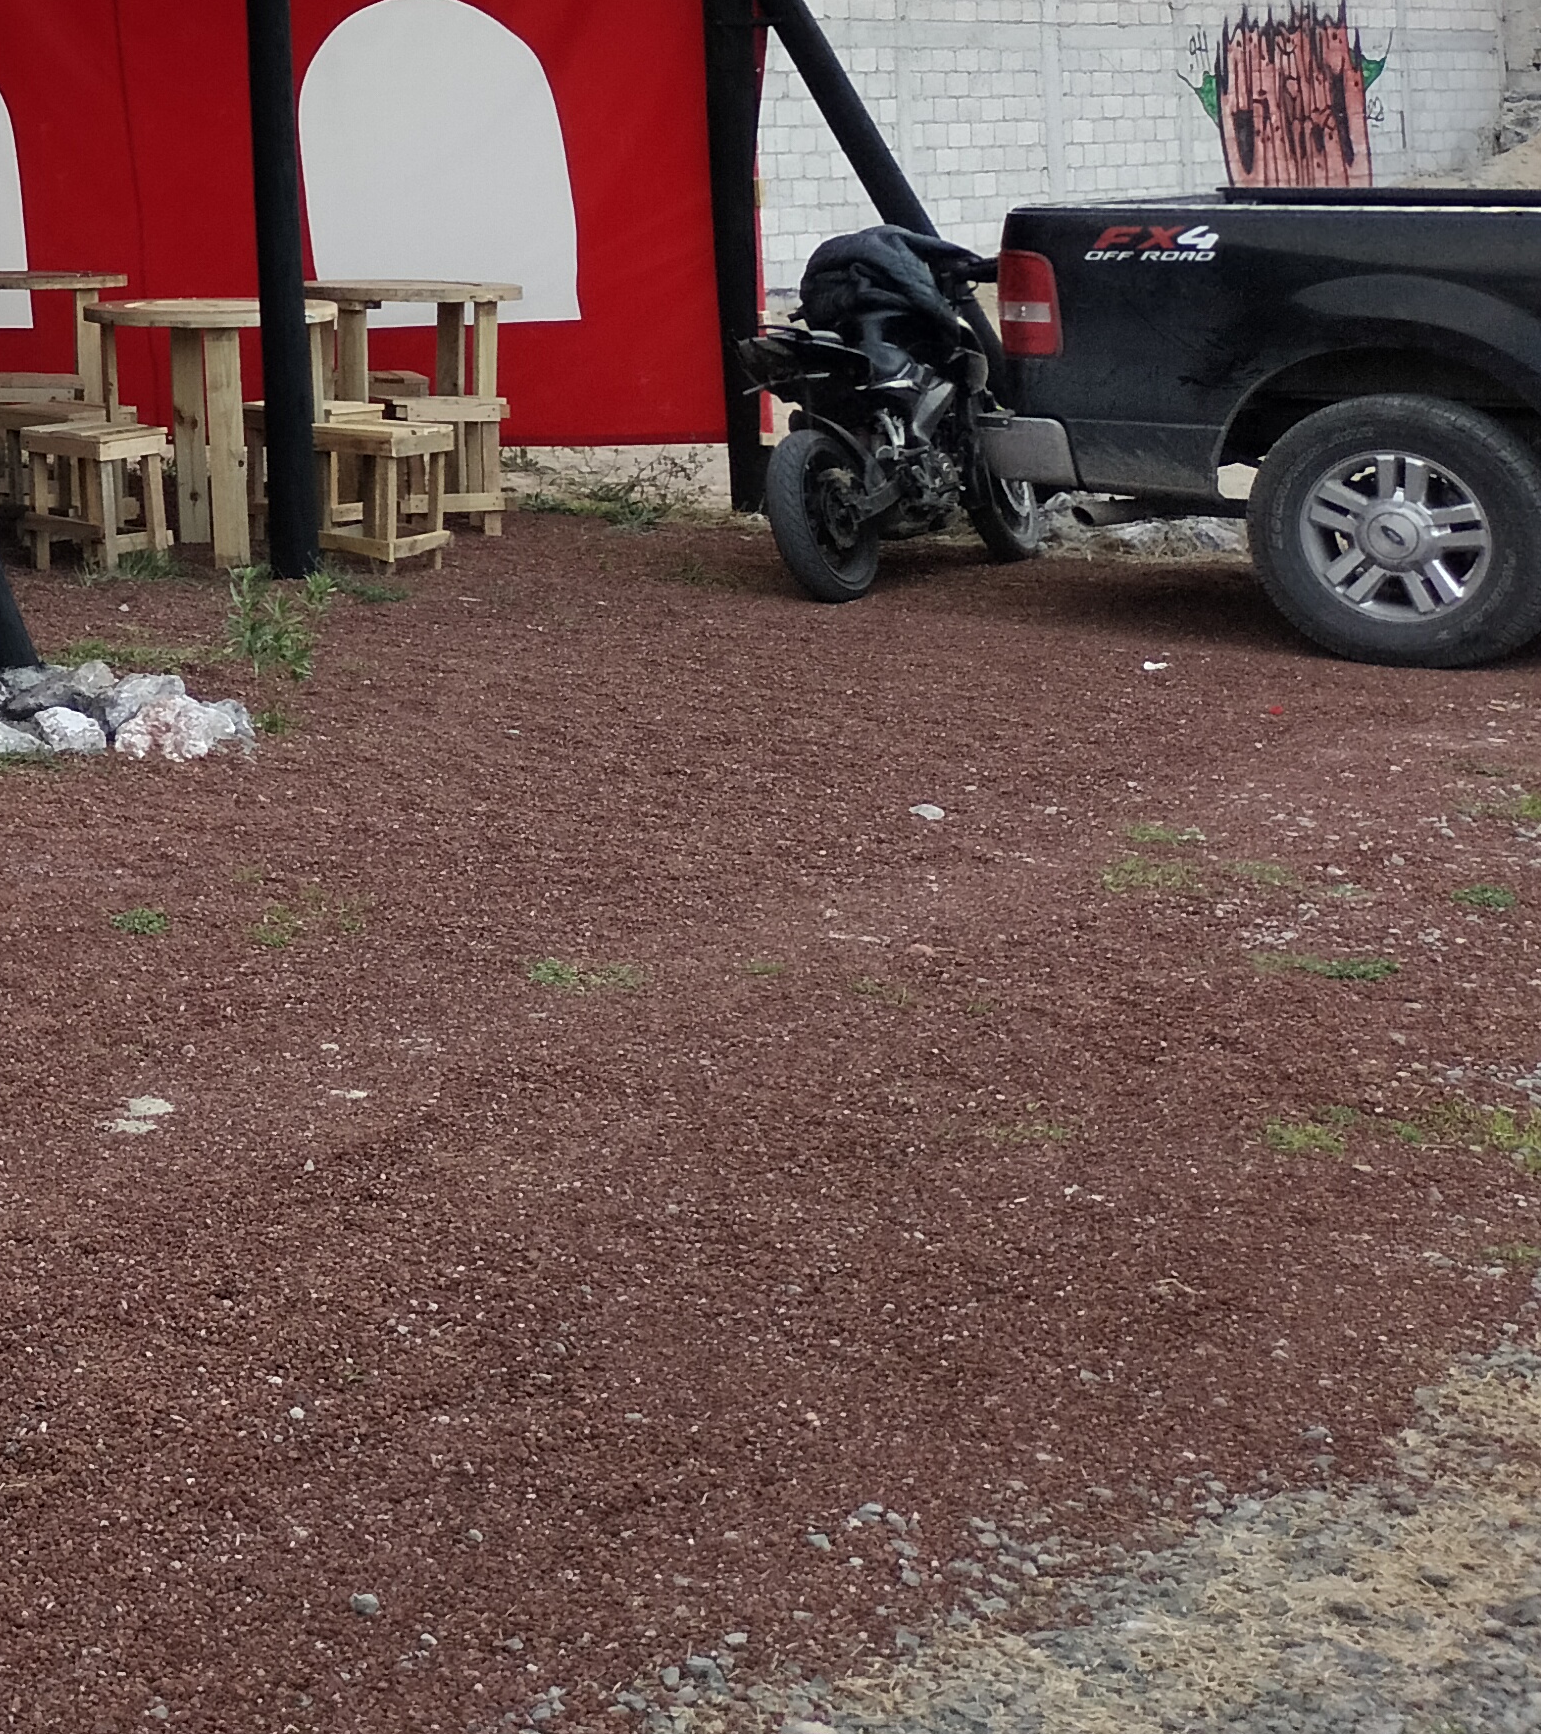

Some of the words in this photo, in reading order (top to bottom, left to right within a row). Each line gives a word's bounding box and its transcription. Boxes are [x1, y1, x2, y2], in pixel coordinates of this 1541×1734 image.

[1092, 225, 1220, 250] FX4
[1083, 250, 1136, 262] OFF
[1139, 250, 1217, 262] ROAD
